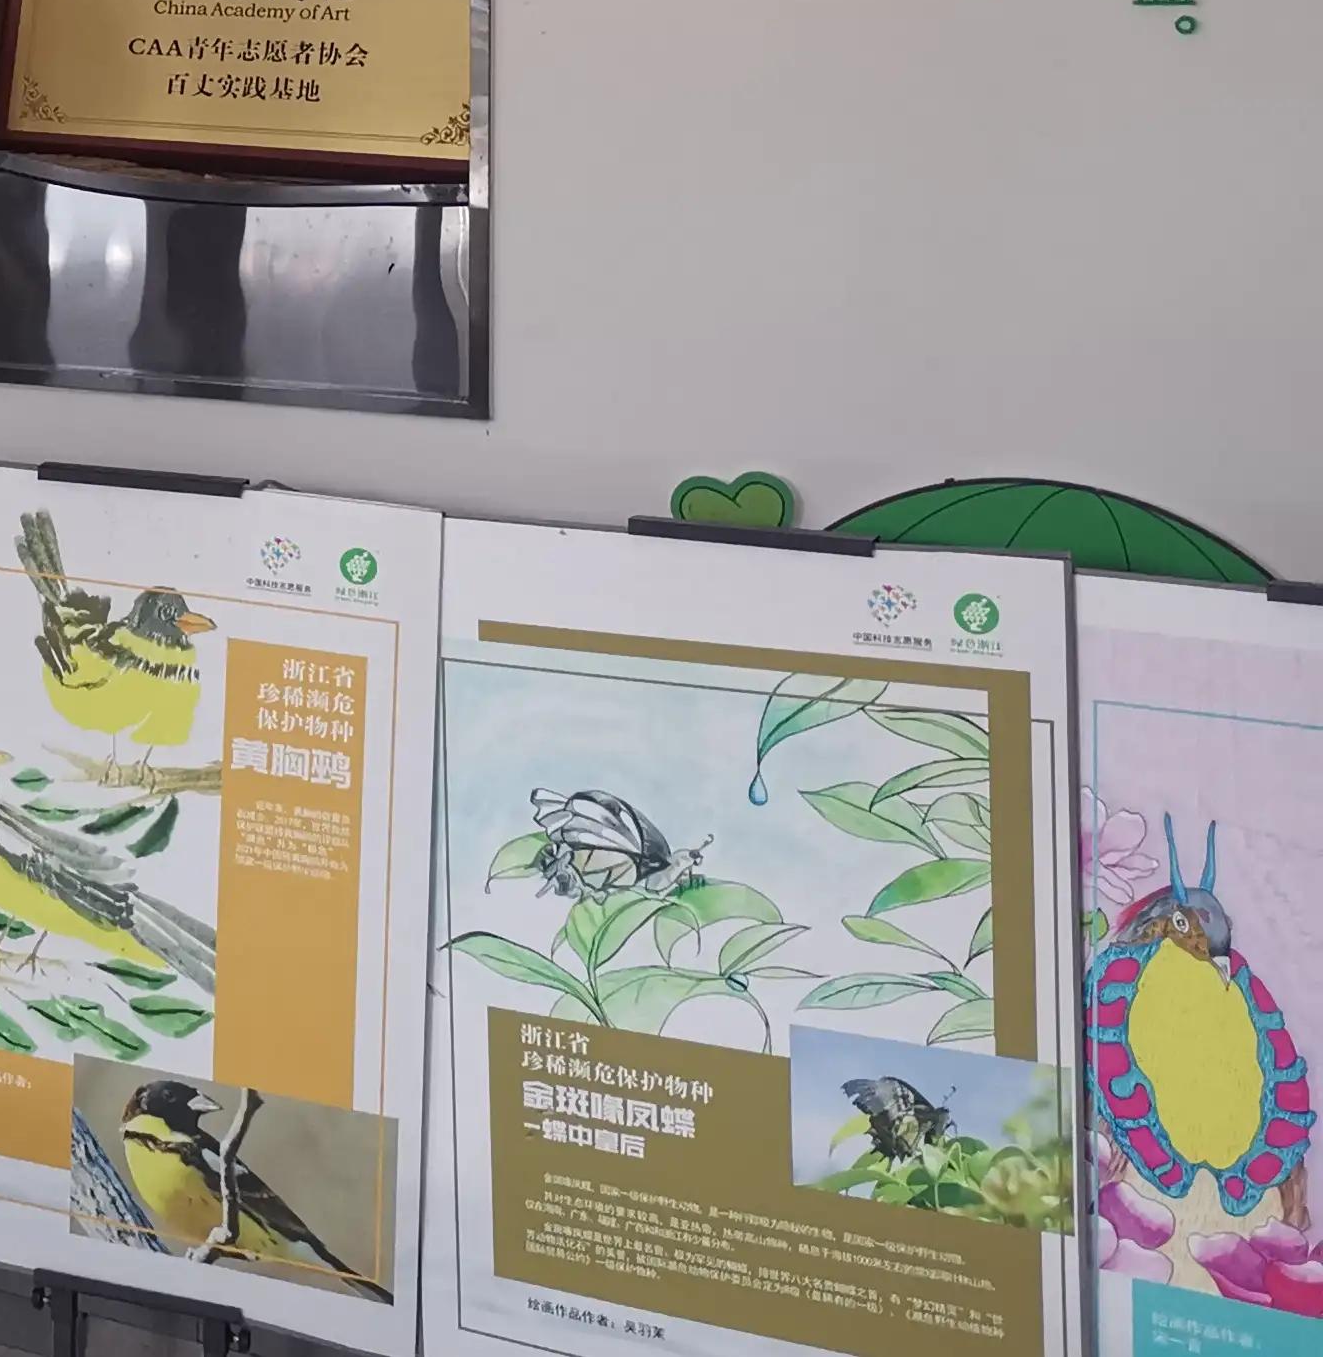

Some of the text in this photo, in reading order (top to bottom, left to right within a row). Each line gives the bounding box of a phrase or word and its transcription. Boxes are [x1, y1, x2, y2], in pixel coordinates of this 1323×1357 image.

[154, 0, 351, 23] China Academy of Art
[128, 36, 369, 68] CAA青年志愿者协会
[166, 74, 321, 103] 百丈实践基地
[283, 659, 355, 688] 浙江省
[257, 683, 355, 715] 珍稀濒危
[257, 706, 354, 743] 保护物种
[231, 737, 351, 789] 黄胸鹀
[520, 1023, 590, 1055] 浙江省
[521, 1050, 714, 1104] 珍稀濒危保护物种
[523, 1080, 696, 1138] 金斑喙凤蝶
